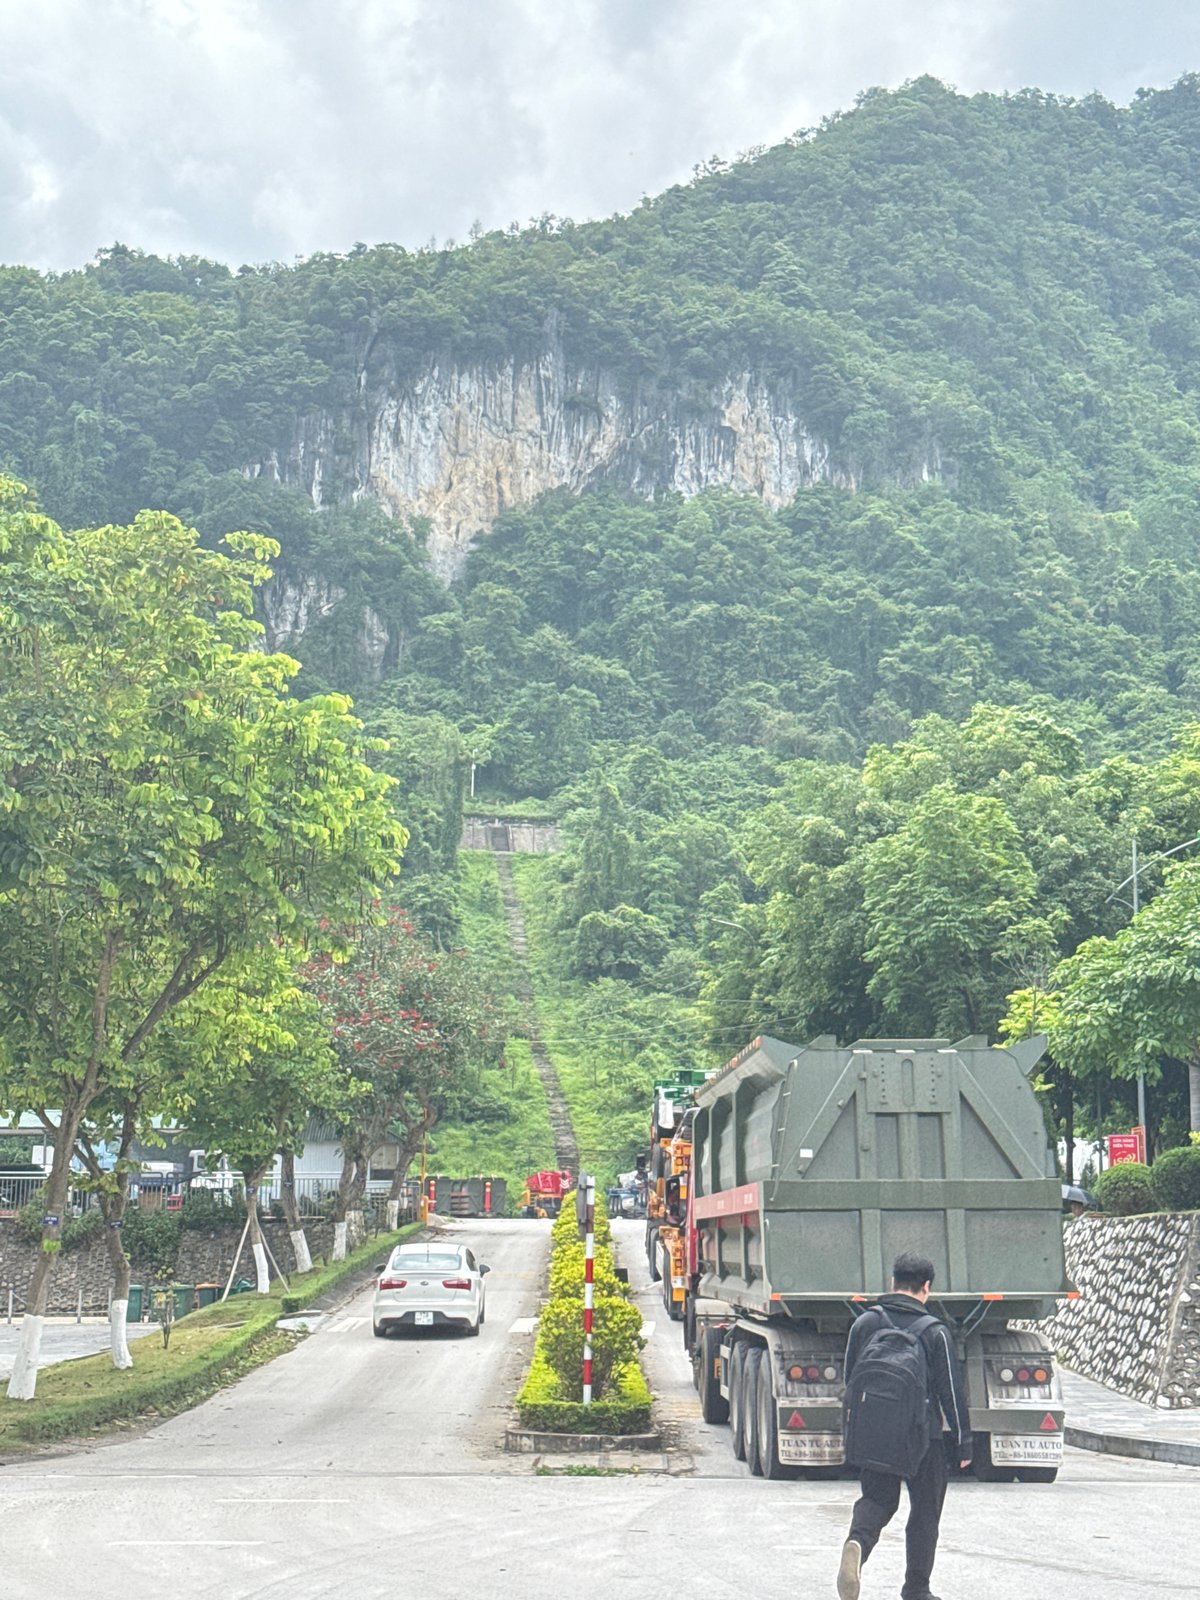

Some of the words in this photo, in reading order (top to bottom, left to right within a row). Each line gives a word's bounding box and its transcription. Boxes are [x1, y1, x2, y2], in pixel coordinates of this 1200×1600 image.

[781, 1439, 807, 1448] TUAN
[808, 1440, 822, 1448] TU
[824, 1440, 843, 1448] AUT
[994, 1440, 1021, 1449] TUAN
[1022, 1440, 1036, 1449] TU
[1039, 1441, 1062, 1450] AUTO
